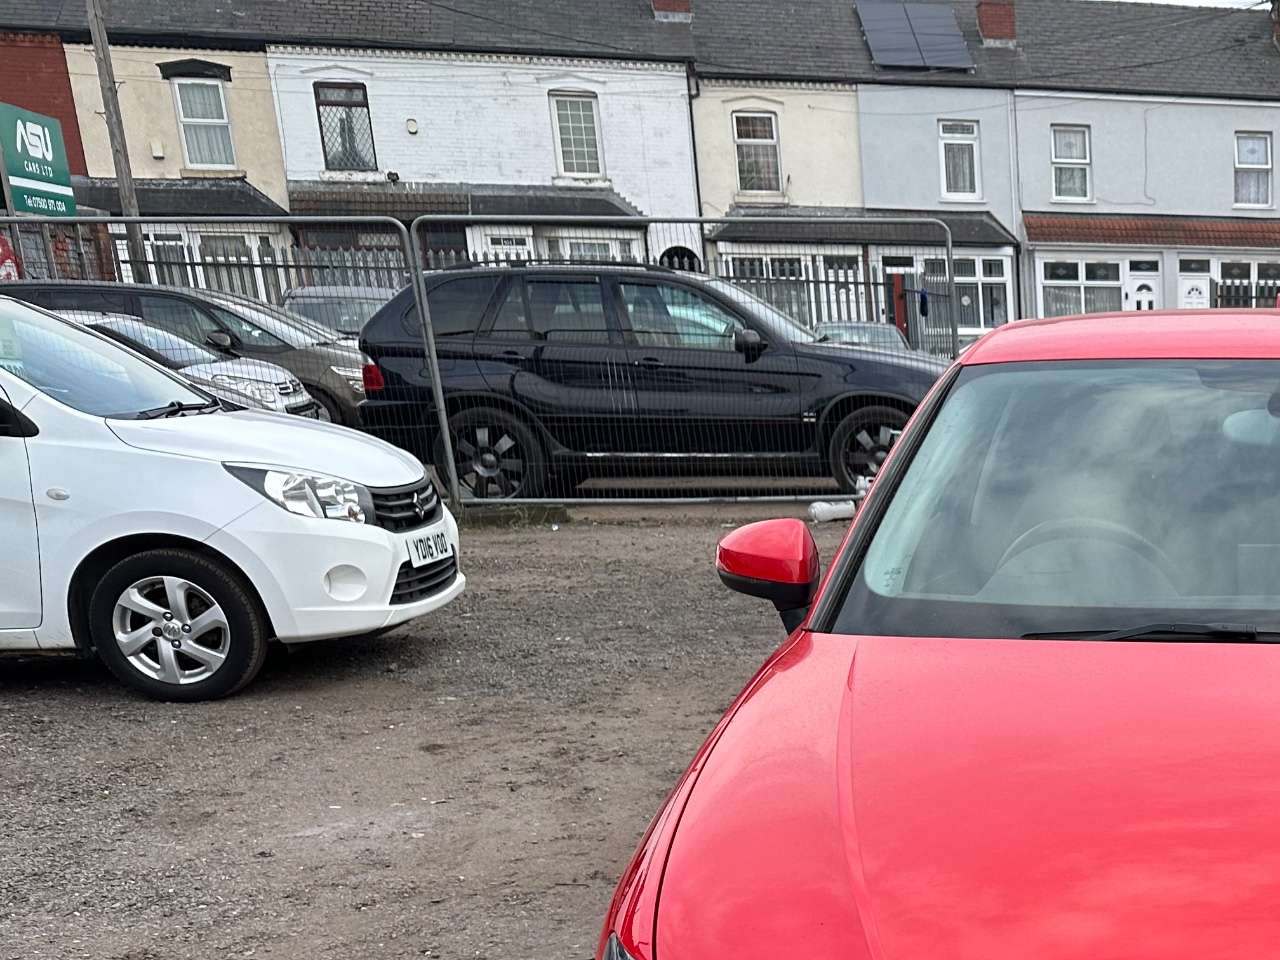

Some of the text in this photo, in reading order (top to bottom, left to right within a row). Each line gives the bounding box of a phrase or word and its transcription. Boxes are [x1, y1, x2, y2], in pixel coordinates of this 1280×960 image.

[24, 160, 53, 178] CARS LTD
[412, 537, 434, 561] YD16
